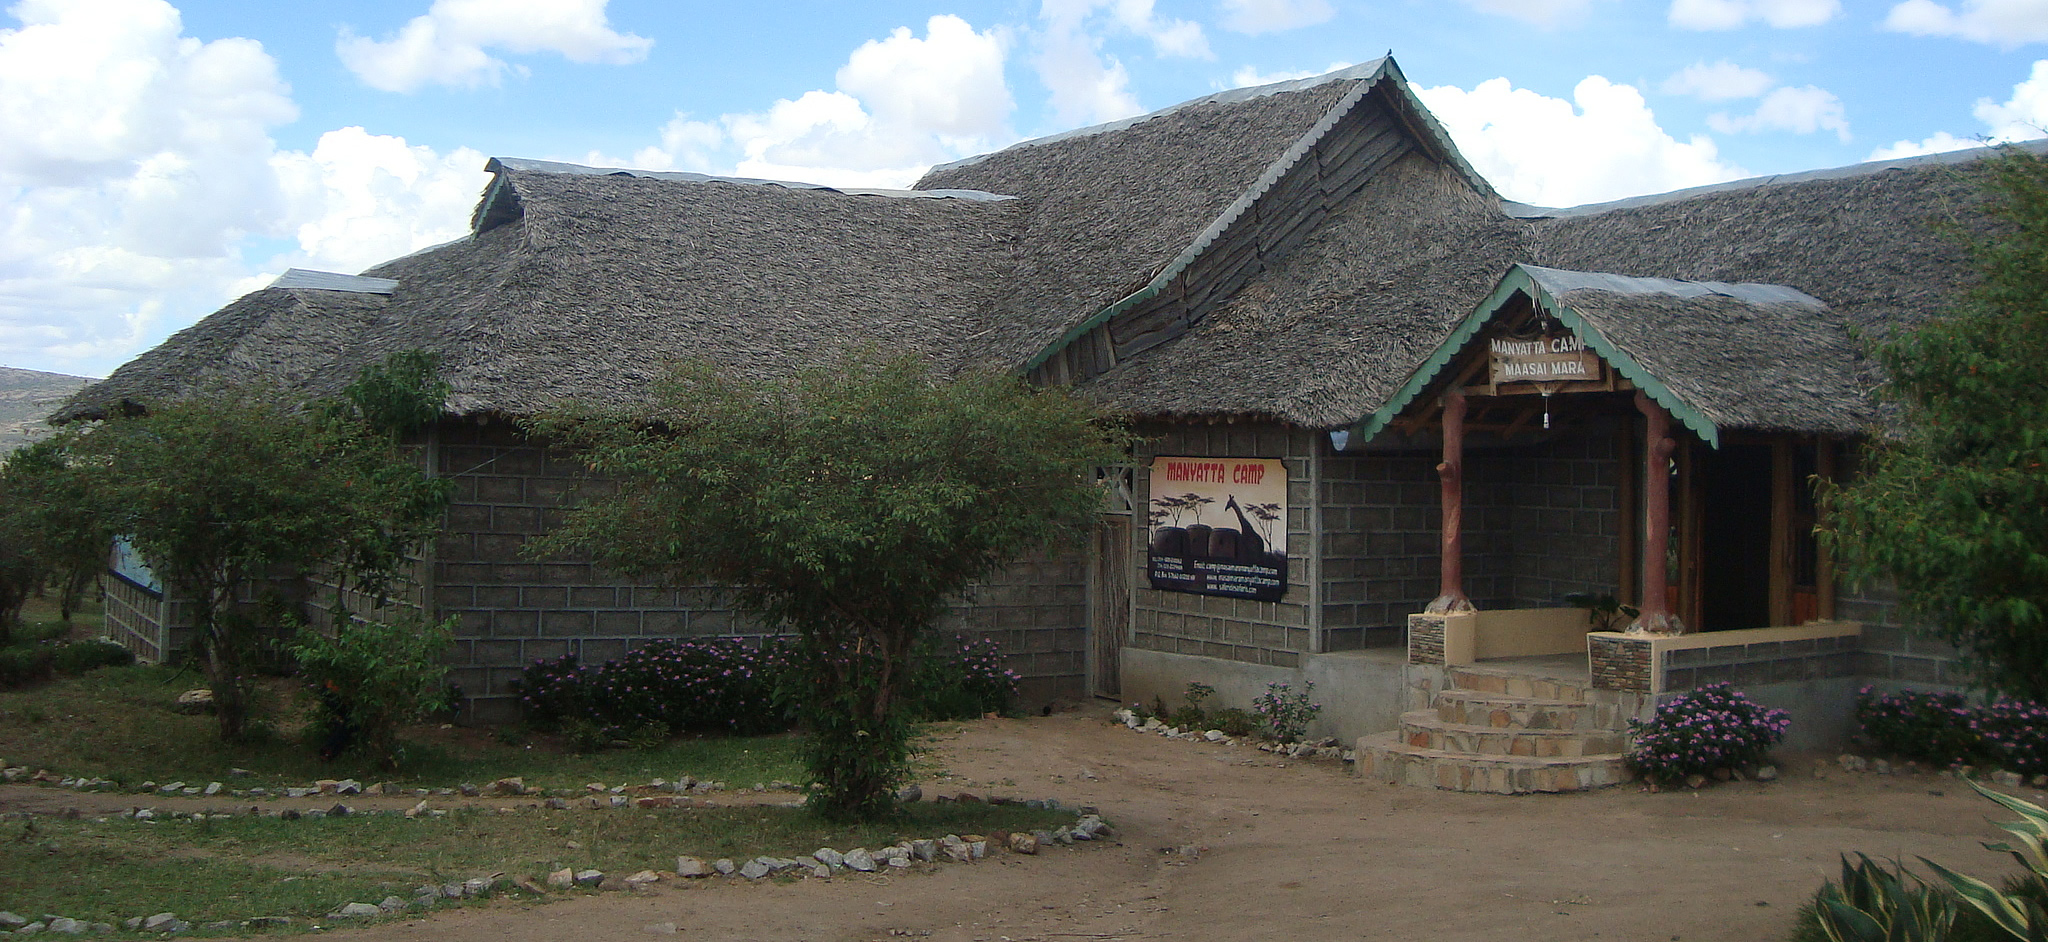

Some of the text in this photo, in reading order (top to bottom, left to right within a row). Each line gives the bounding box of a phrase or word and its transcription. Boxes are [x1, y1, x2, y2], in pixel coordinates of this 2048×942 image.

[1491, 338, 1546, 355] MANYATTA
[1505, 361, 1585, 376] MAASAI MARA
[1166, 461, 1265, 485] MANYATTA CAMP
